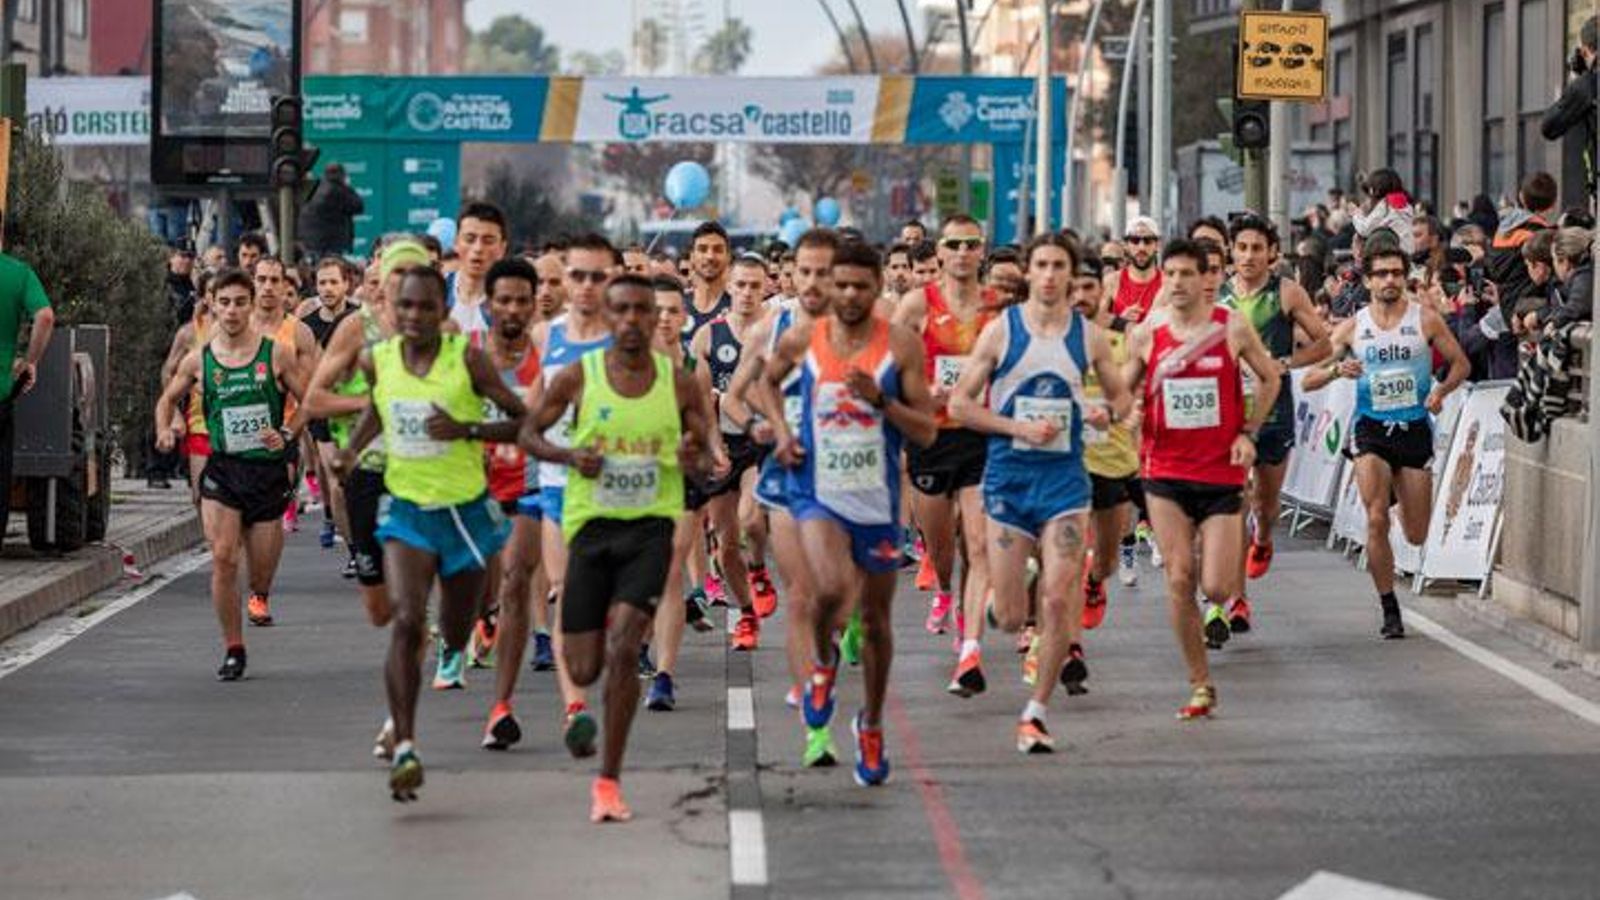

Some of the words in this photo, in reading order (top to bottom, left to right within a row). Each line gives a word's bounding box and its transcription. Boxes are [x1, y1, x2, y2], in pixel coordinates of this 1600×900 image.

[1377, 379, 1414, 396] 2100
[1172, 392, 1215, 410] 2038
[827, 450, 877, 470] 2006
[603, 471, 656, 490] 2003
